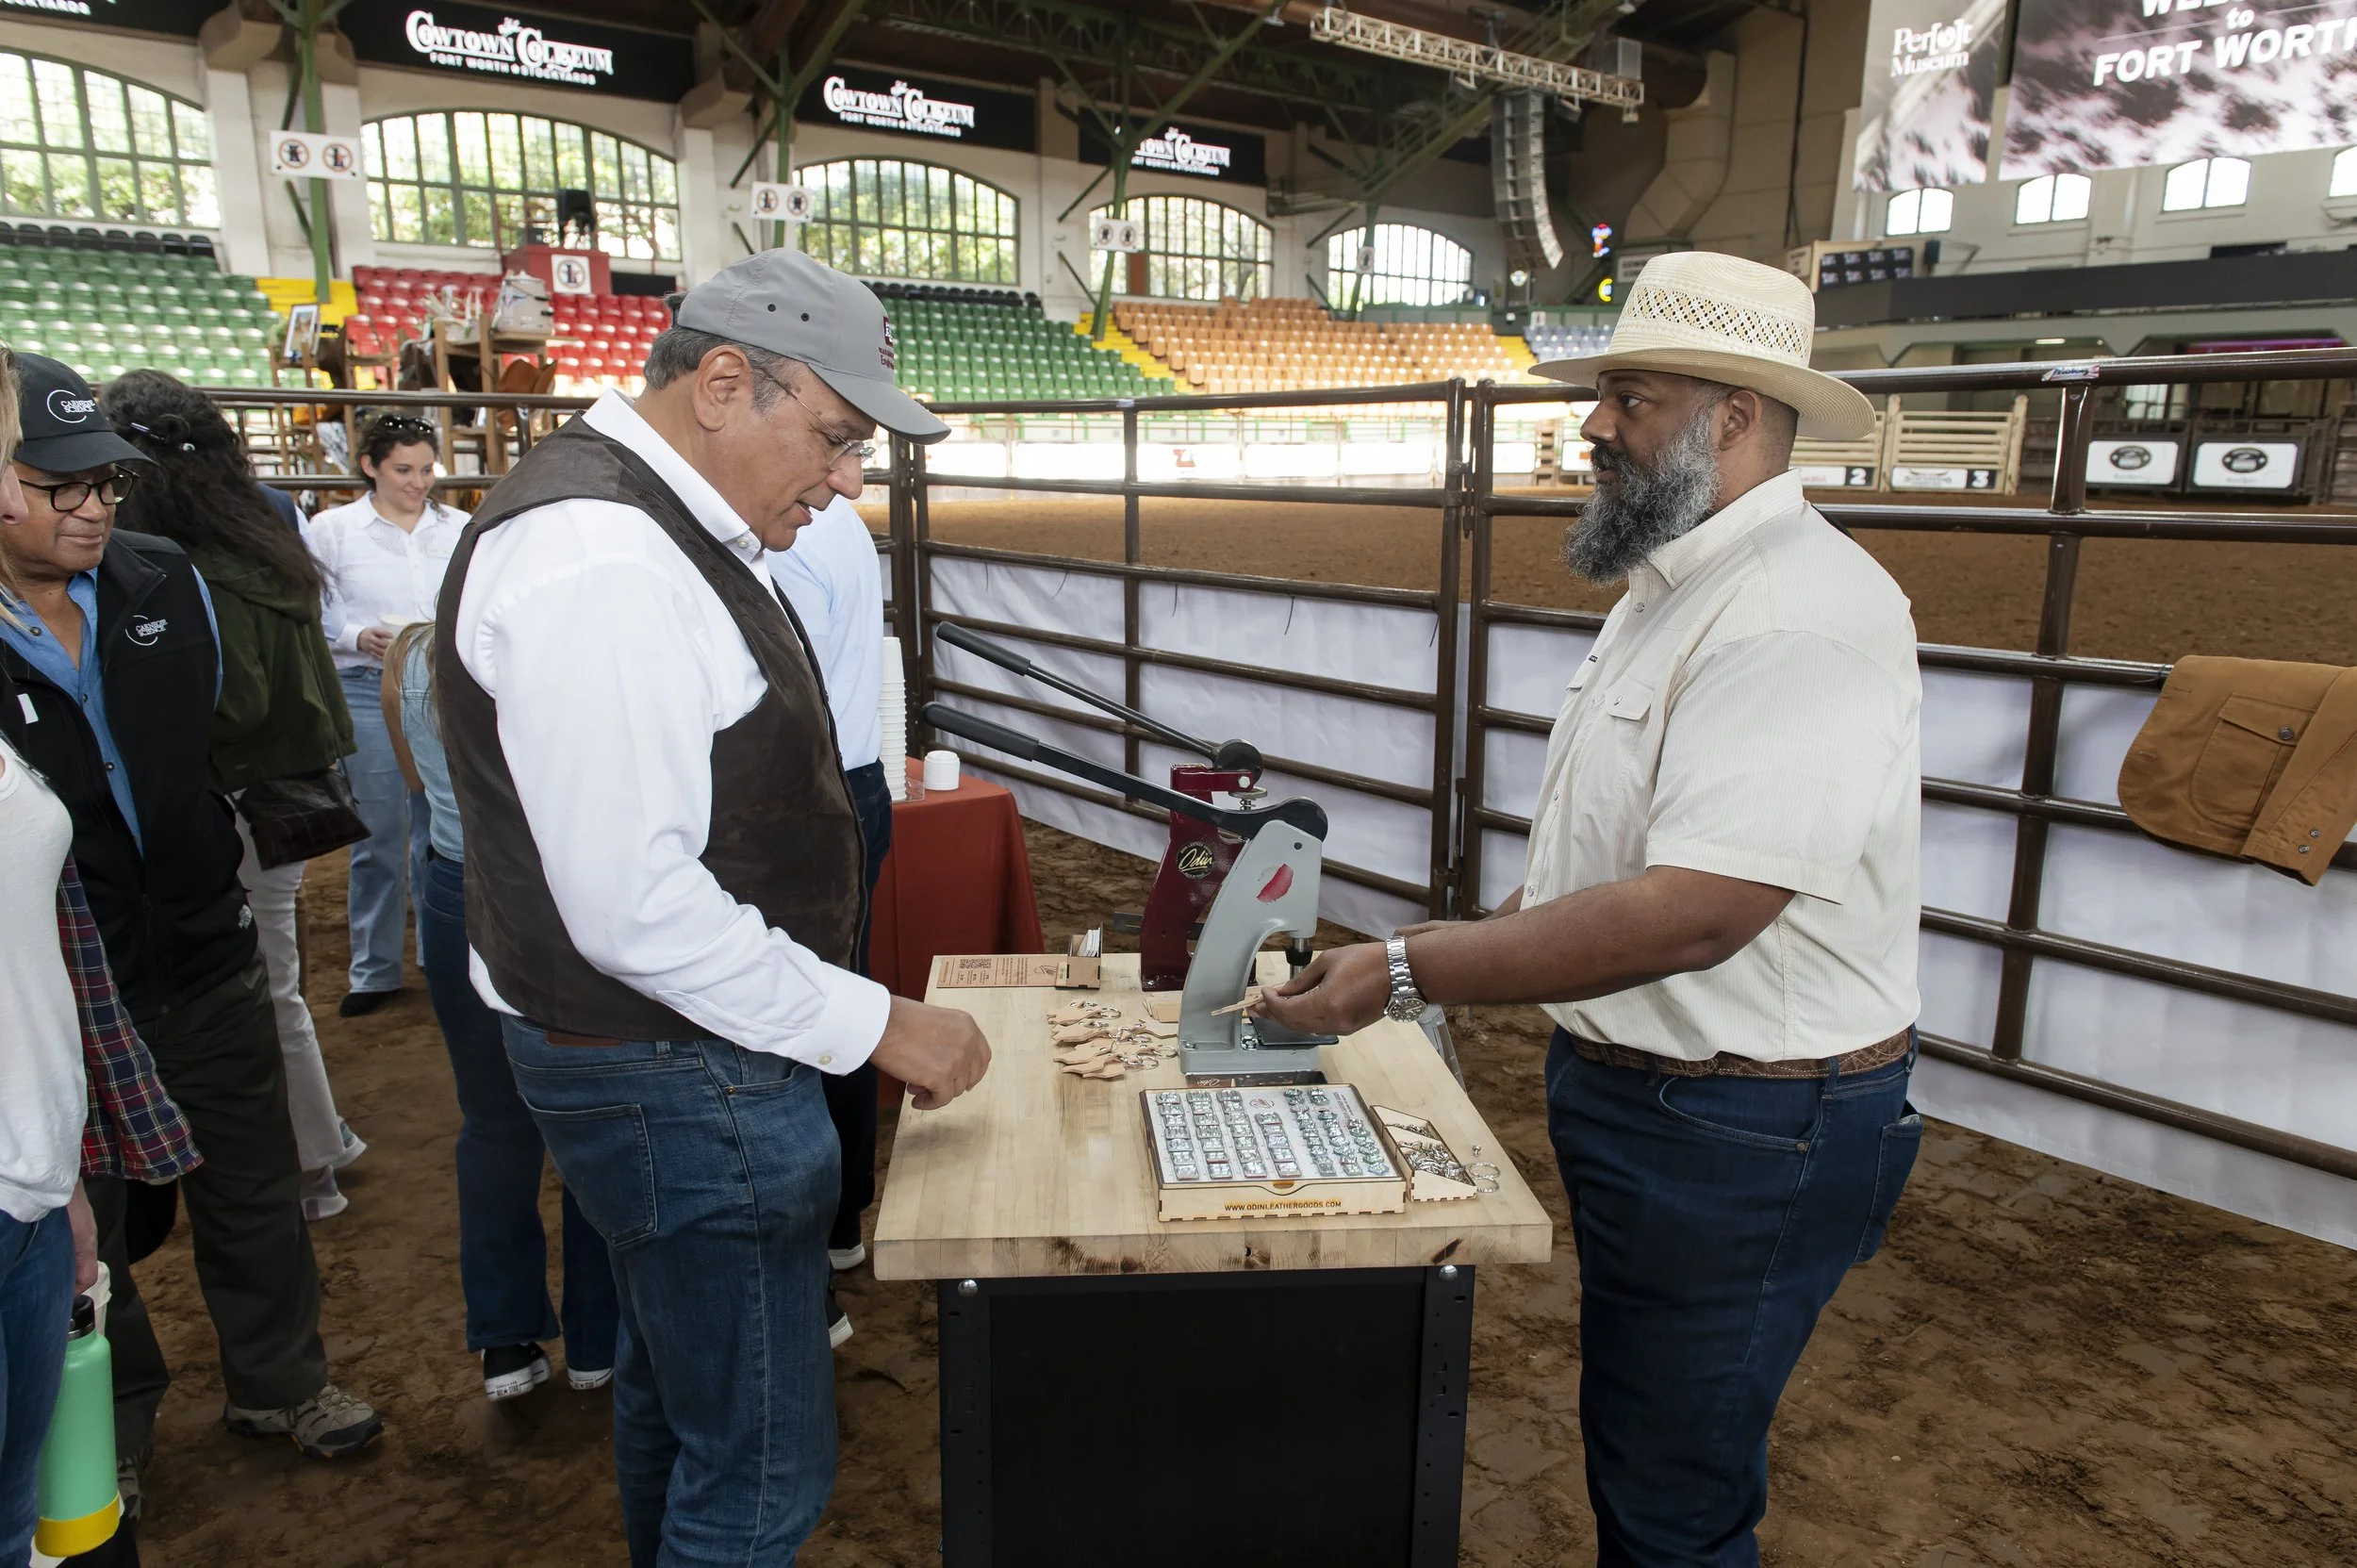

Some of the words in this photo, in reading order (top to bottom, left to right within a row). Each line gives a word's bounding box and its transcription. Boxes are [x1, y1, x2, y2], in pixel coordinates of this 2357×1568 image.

[2226, 8, 2254, 29] to
[406, 9, 515, 60] COWTOWN
[517, 26, 614, 75] COLISEUM
[430, 52, 463, 67] FORT
[466, 57, 509, 74] WORTH
[520, 64, 596, 86] STOCKYARDS
[1890, 52, 1970, 77] Museum
[2093, 41, 2202, 86] FORT
[823, 75, 902, 118] COWTOWN
[839, 111, 865, 124] FORT
[865, 114, 898, 128] WORTH
[1850, 468, 1867, 486] 2
[1971, 470, 1989, 488] 3
[136, 619, 168, 632] CARNEGIE
[139, 625, 166, 636] SCIENCE
[1178, 848, 1212, 870] Odin
[1225, 1201, 1342, 1212] WWW.ODINLEATHERGOODS.COM
